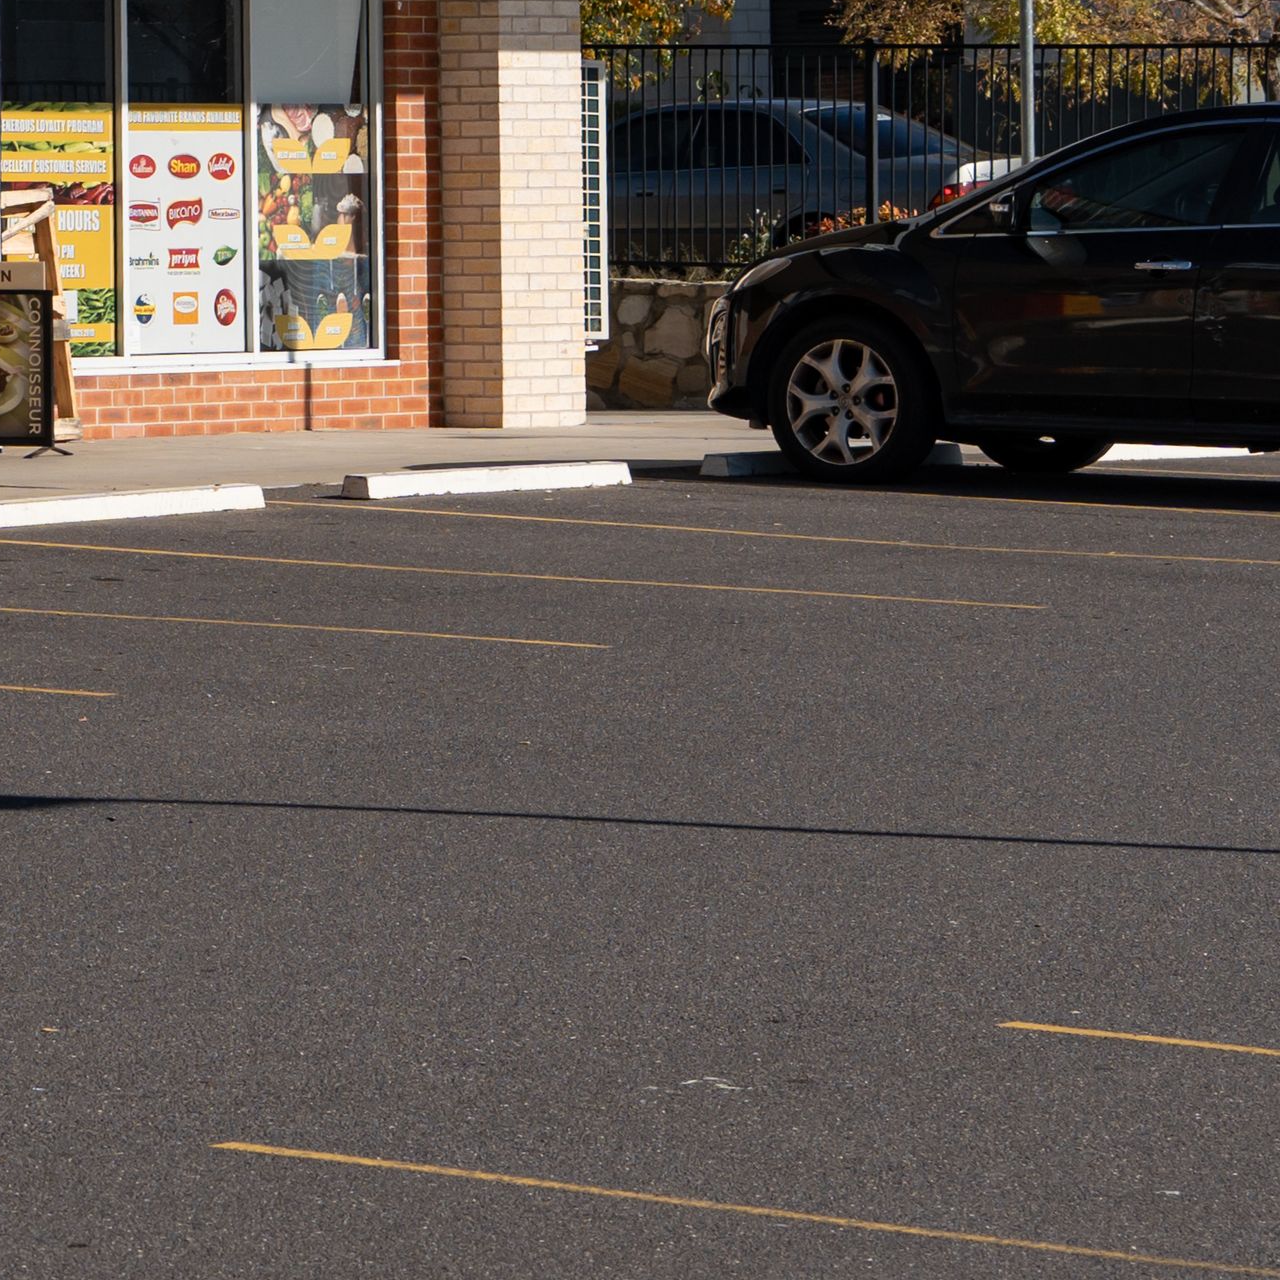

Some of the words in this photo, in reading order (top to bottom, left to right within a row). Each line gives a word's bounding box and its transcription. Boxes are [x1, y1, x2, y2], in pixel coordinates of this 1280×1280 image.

[1, 120, 35, 133] ENEROUS
[36, 120, 66, 133] LOYALTY
[67, 120, 104, 133] PROGRAM
[35, 160, 74, 173] CUSTOMER
[76, 160, 107, 173] SERVICE
[170, 159, 197, 173] Shan
[57, 210, 101, 232] HOURS
[61, 244, 75, 259] PM
[171, 250, 196, 267] priya
[28, 297, 42, 434] CONNOISSEUR
